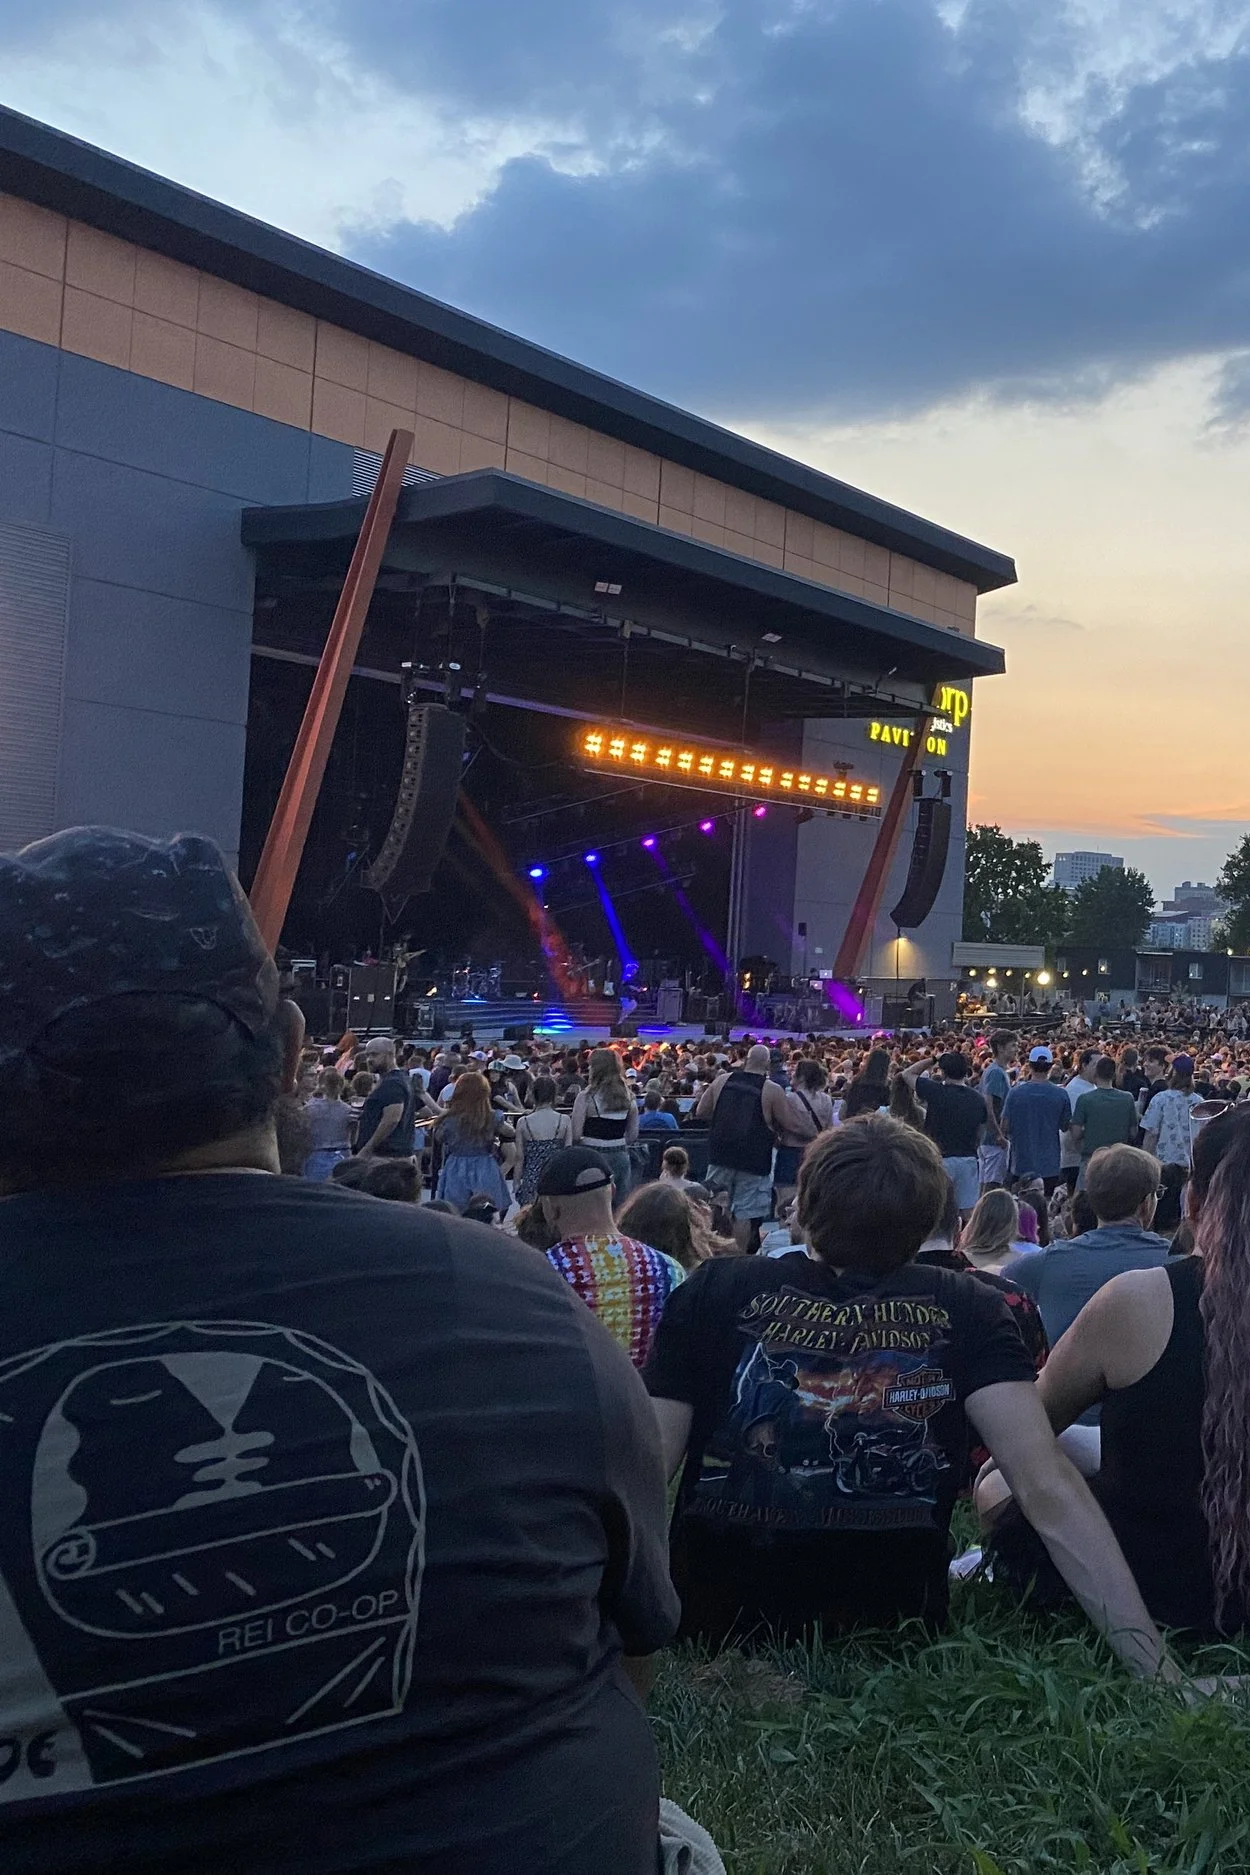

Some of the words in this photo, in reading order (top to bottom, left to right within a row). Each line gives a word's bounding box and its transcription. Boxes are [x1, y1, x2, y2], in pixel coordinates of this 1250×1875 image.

[870, 721, 946, 756] PAVION
[218, 1617, 274, 1656] REI
[285, 1590, 398, 1636] CO-OP
